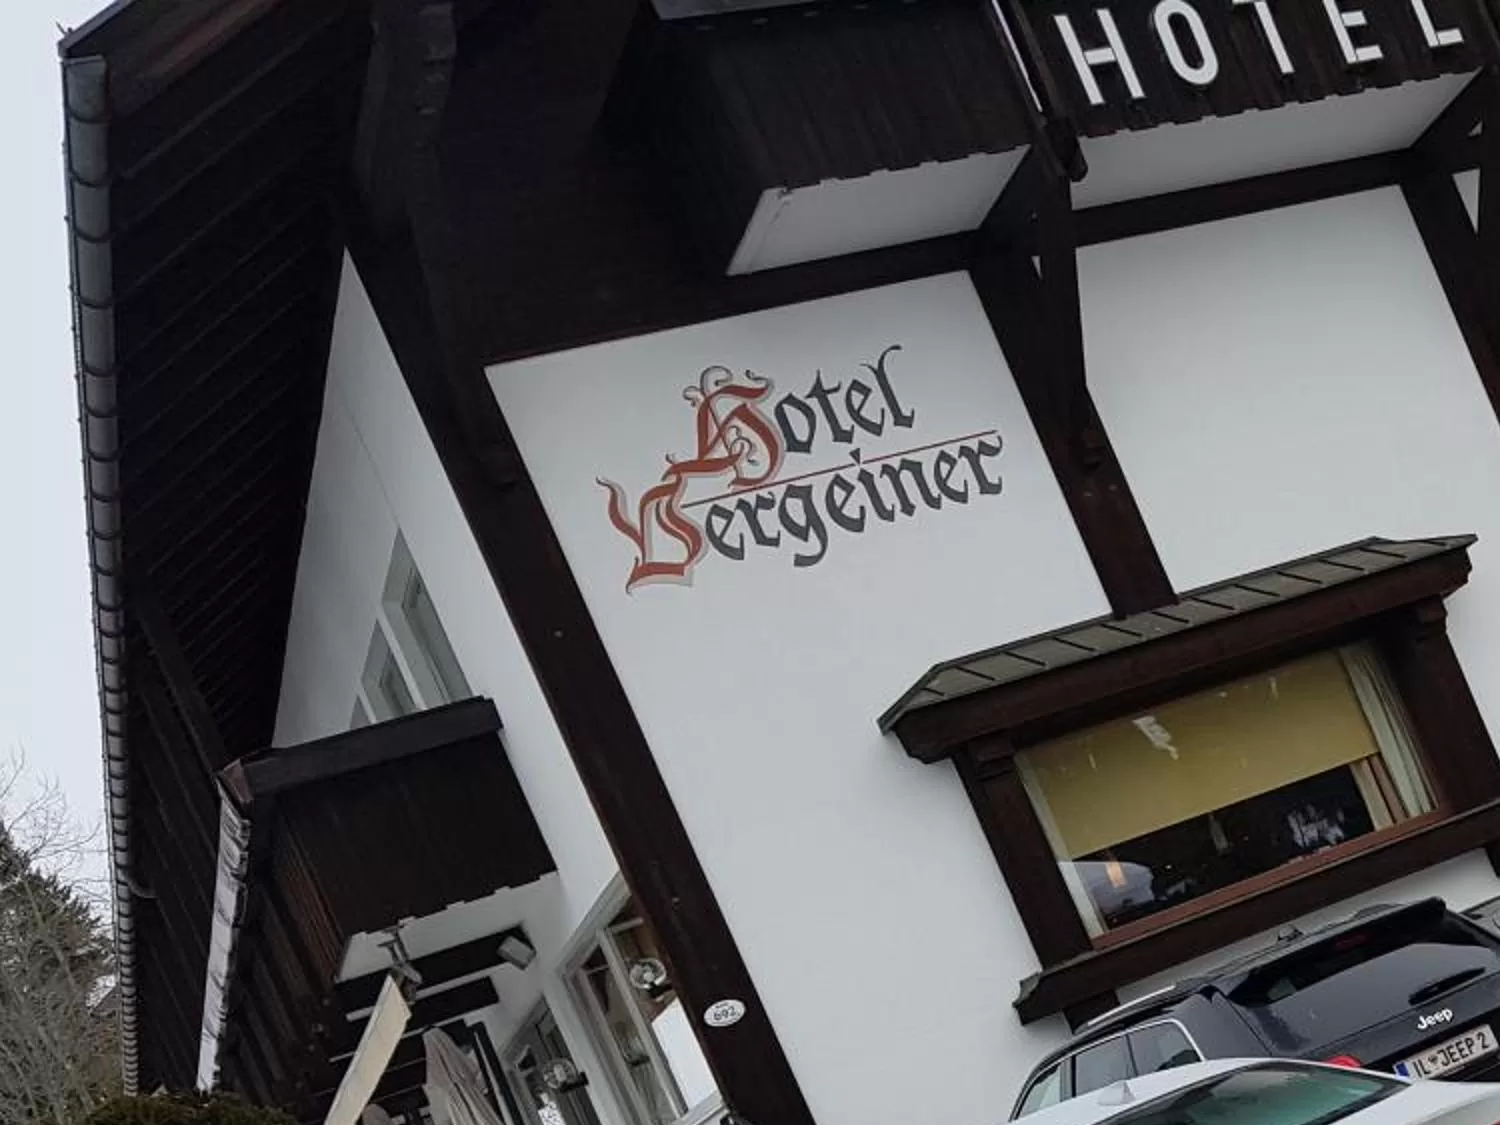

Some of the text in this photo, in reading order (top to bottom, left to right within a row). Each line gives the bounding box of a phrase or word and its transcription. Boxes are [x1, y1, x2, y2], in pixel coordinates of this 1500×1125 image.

[1054, 0, 1464, 105] HOTEL
[662, 345, 916, 489] Hotel
[1416, 1007, 1454, 1030] Jeep
